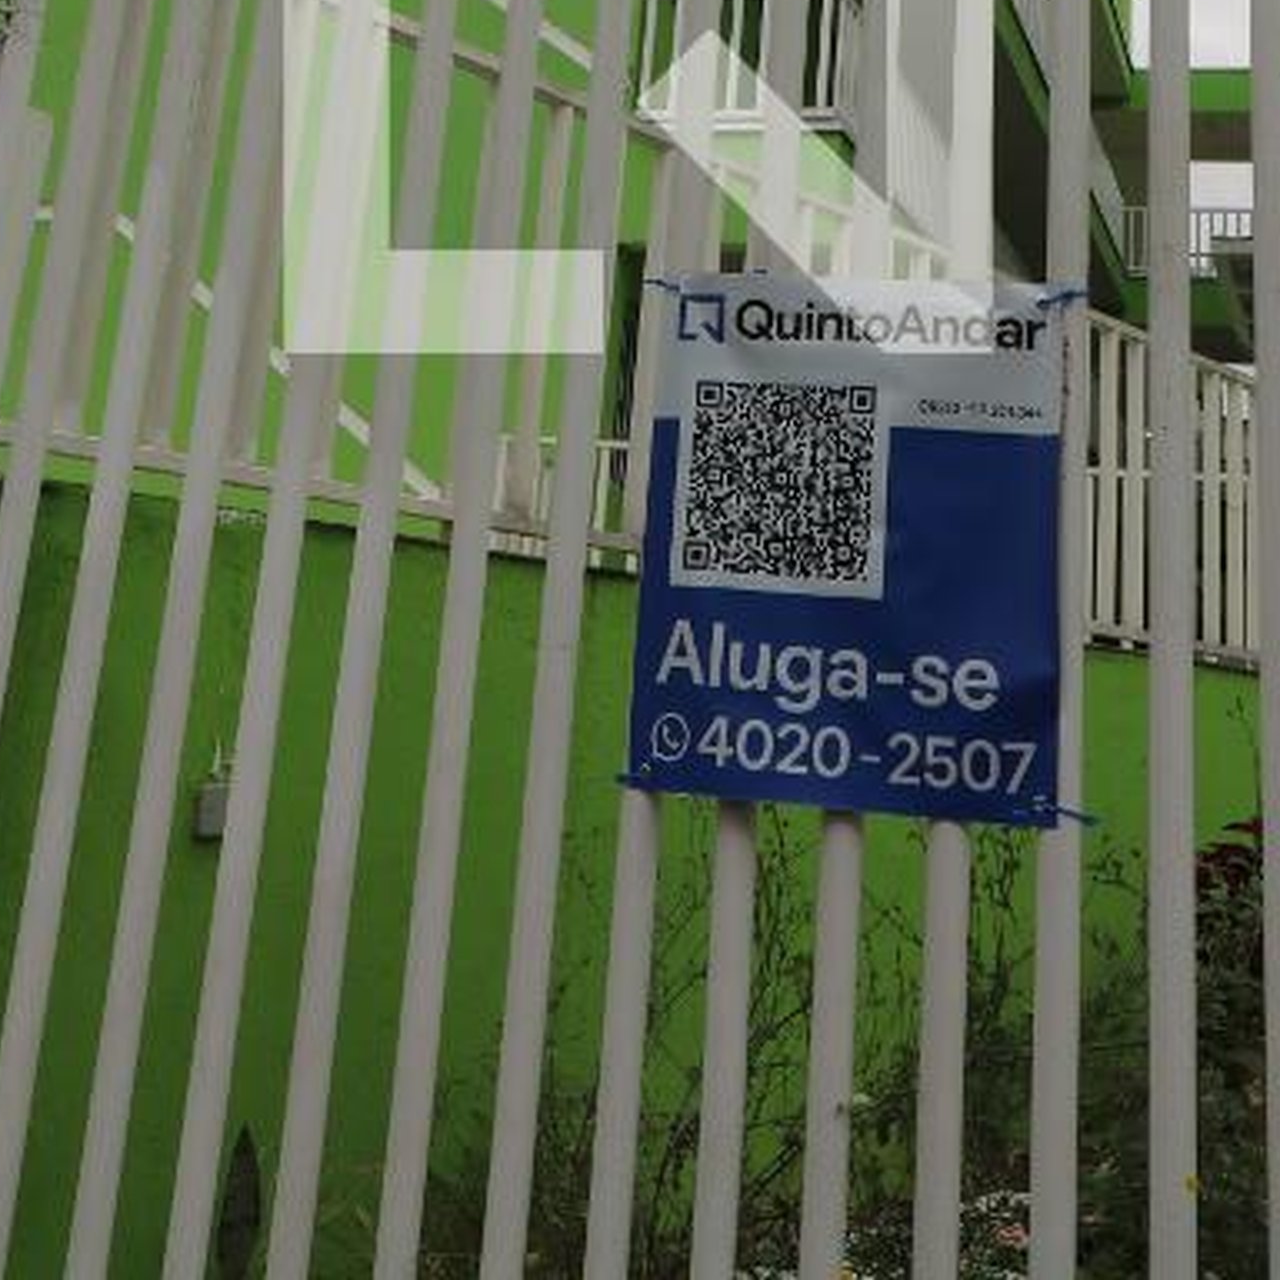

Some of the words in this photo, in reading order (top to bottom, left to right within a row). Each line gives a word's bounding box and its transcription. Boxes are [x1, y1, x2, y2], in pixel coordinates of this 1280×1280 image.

[734, 298, 1047, 351] QuintoAndar
[656, 619, 1000, 713] Aluga-se
[696, 716, 1038, 793] 4020-2507
